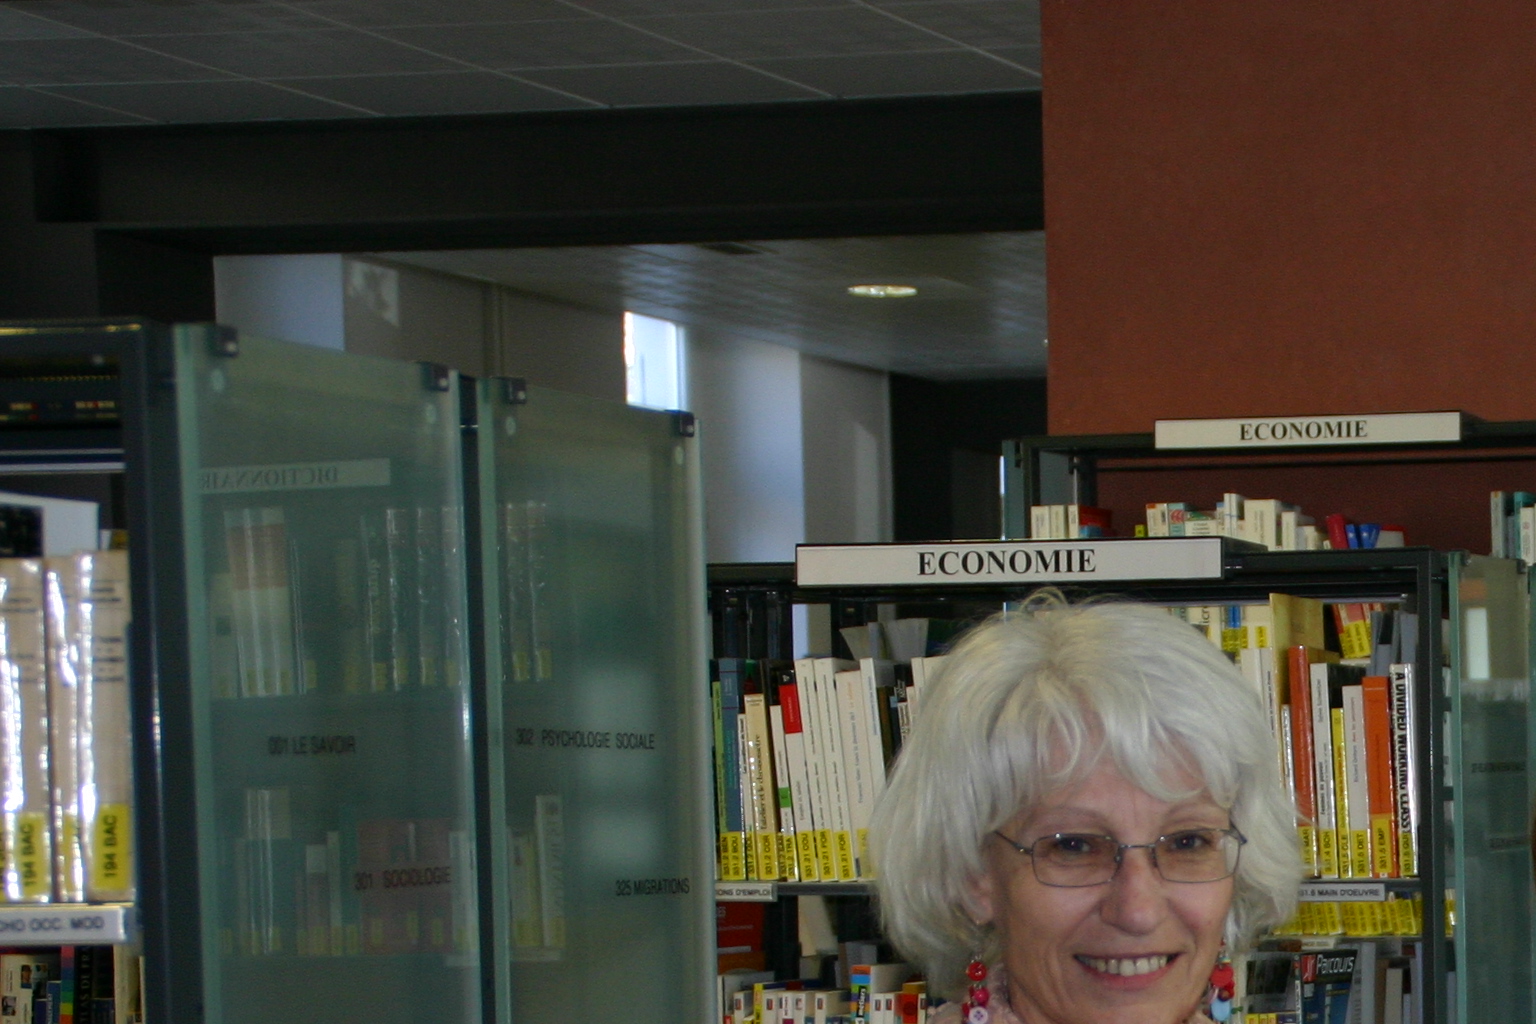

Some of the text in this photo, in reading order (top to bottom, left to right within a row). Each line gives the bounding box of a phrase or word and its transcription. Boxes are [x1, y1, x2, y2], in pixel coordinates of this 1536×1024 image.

[1239, 420, 1369, 442] ECONOMIE
[916, 548, 1097, 577] ECONOMIE
[1396, 683, 1406, 731] DIVIDED
[292, 735, 307, 753] LE
[311, 735, 356, 753] SAVOIR
[541, 729, 610, 748] PSYCHOLOGIE
[615, 733, 655, 749] SOCIALE
[20, 823, 35, 856] BAC
[102, 815, 118, 879] 194 BAC
[763, 835, 772, 874] 331.2 COR
[804, 854, 812, 877] 331.21
[822, 851, 831, 875] 331.21
[841, 854, 849, 878] 331.21
[383, 867, 450, 888] SOCIOLOGIE
[615, 878, 690, 896] 325 MIGRATIONS
[1340, 888, 1381, 896] D'OEUVRE
[856, 988, 866, 1016] métiers
